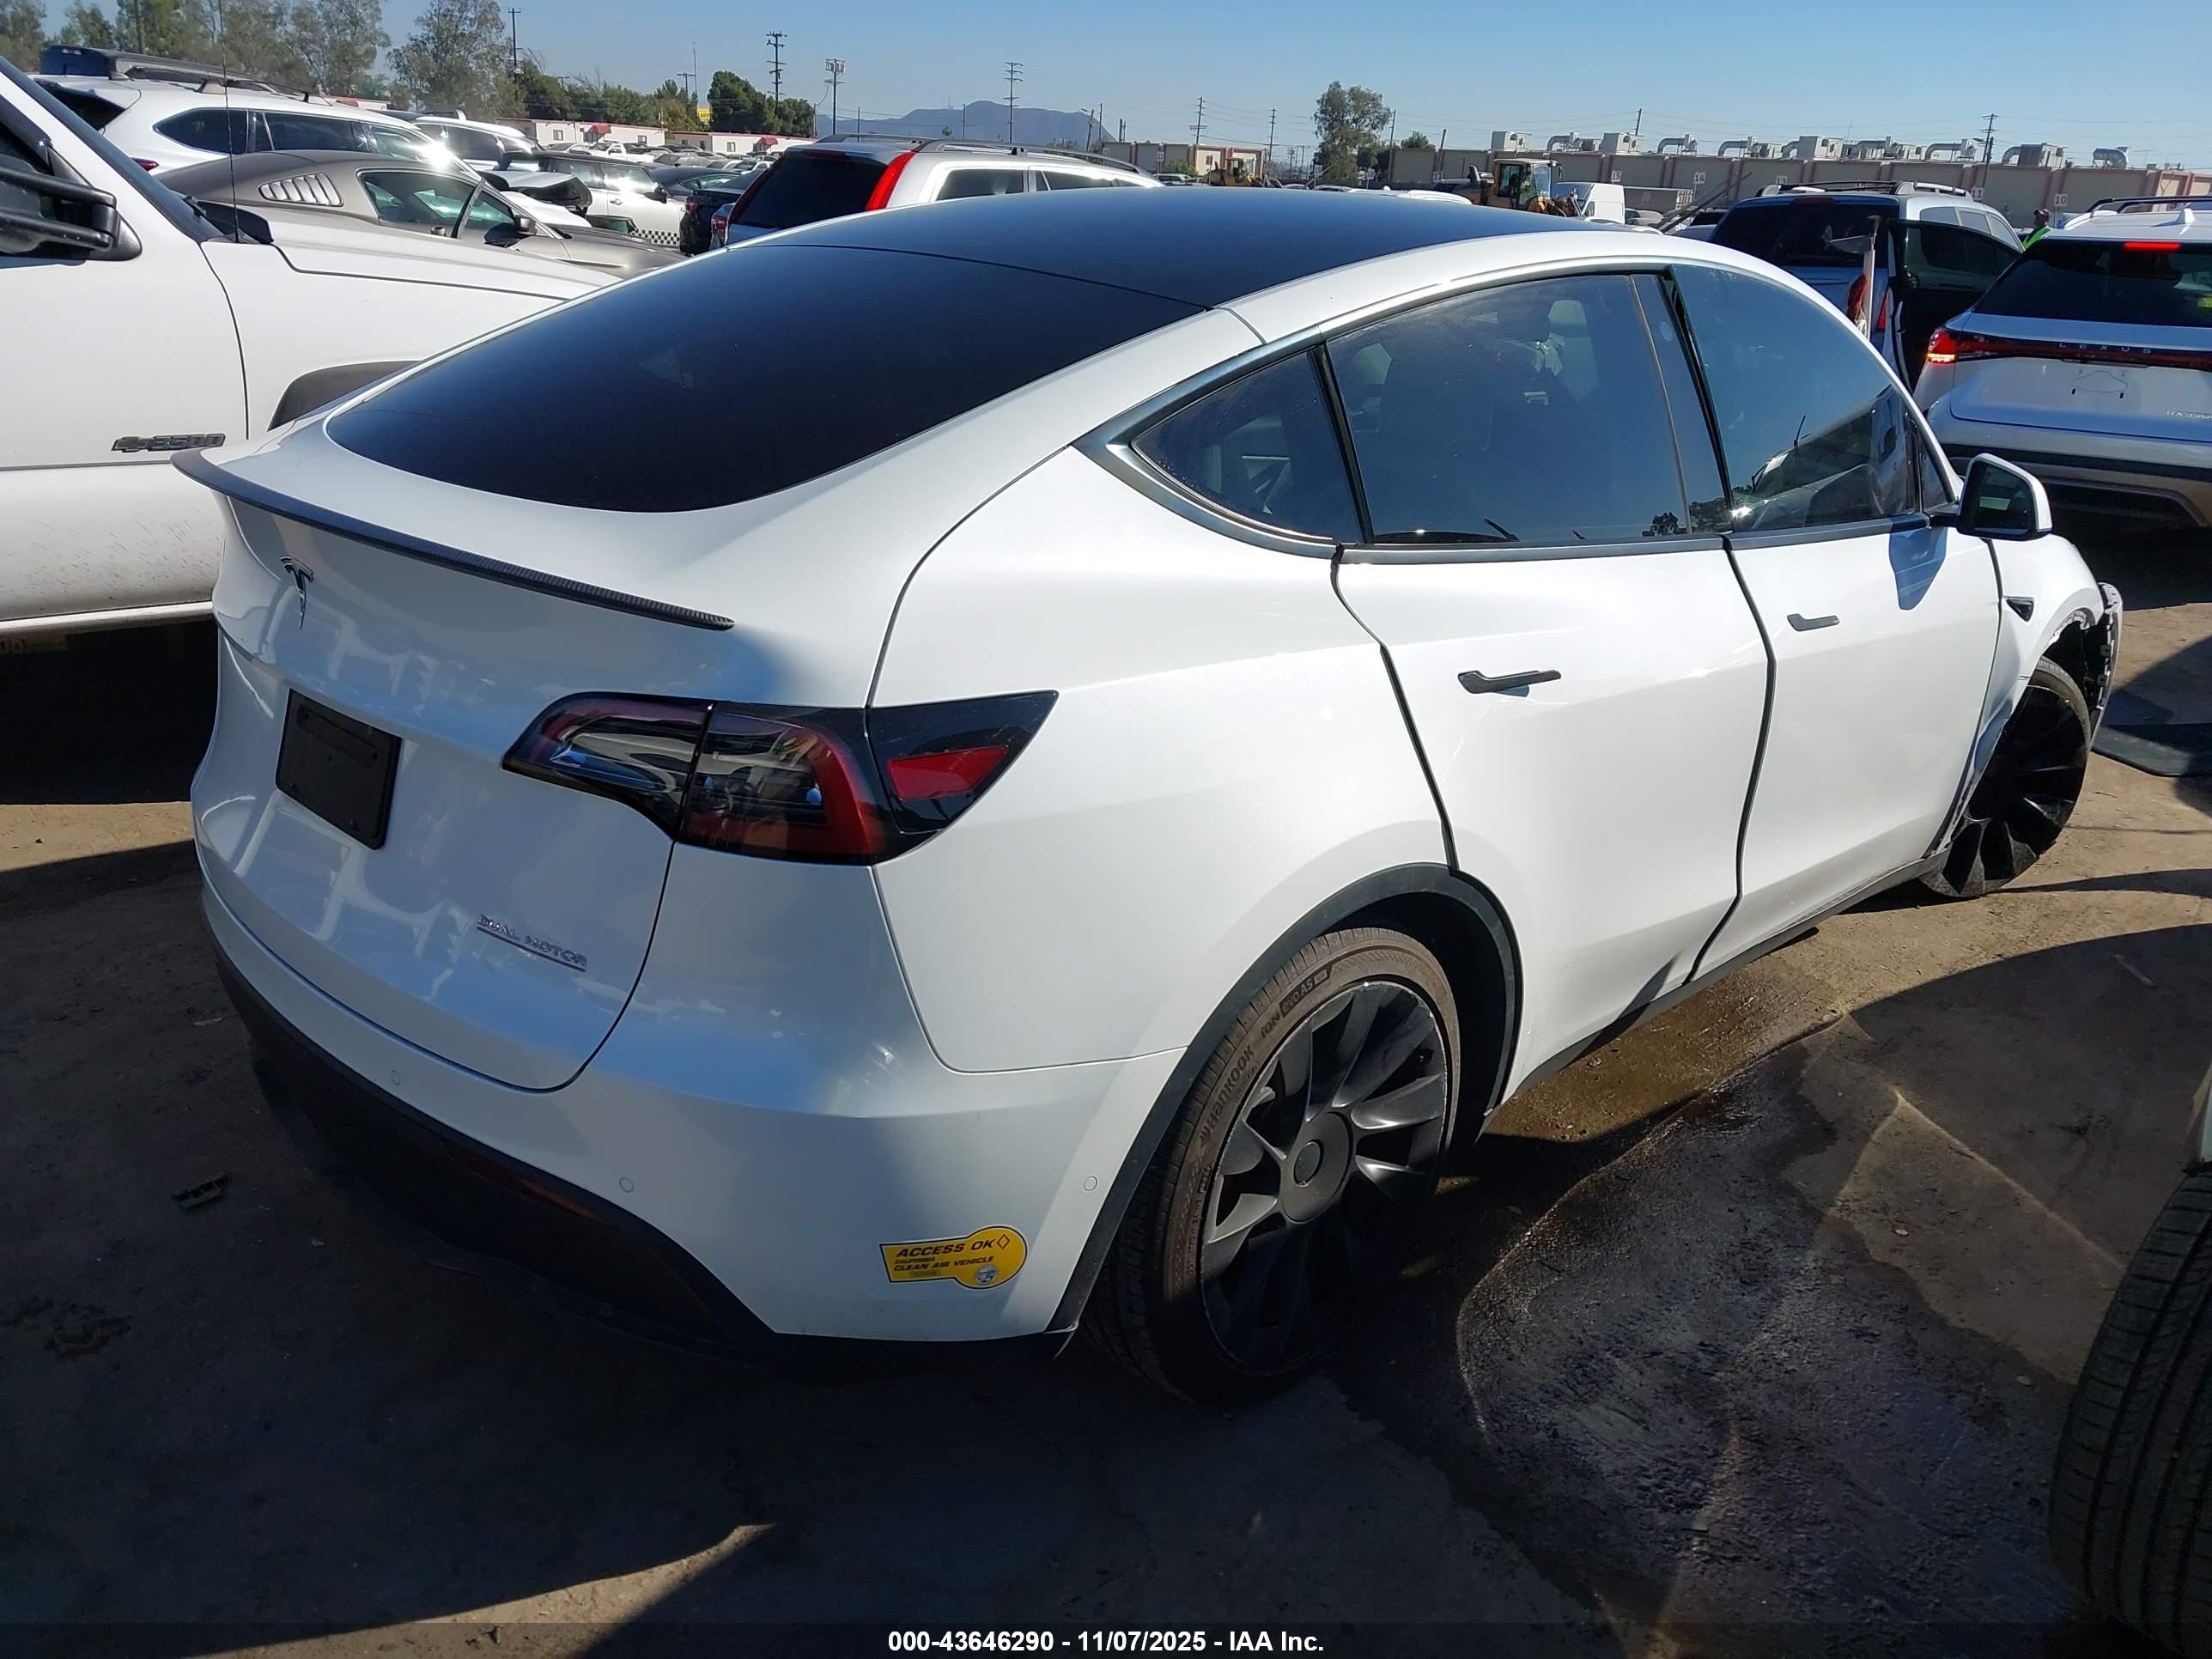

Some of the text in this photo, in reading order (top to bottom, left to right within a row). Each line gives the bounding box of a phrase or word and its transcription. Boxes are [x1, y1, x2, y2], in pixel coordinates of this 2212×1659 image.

[1694, 173, 1705, 181] 14
[2055, 195, 2067, 204] 10
[2058, 342, 2151, 354] LEXUS
[477, 915, 587, 966] DUAL MOTOR
[896, 1238, 995, 1256] ACCESS OK
[933, 1261, 950, 1269] AIR
[954, 1255, 994, 1267] VEHICLE
